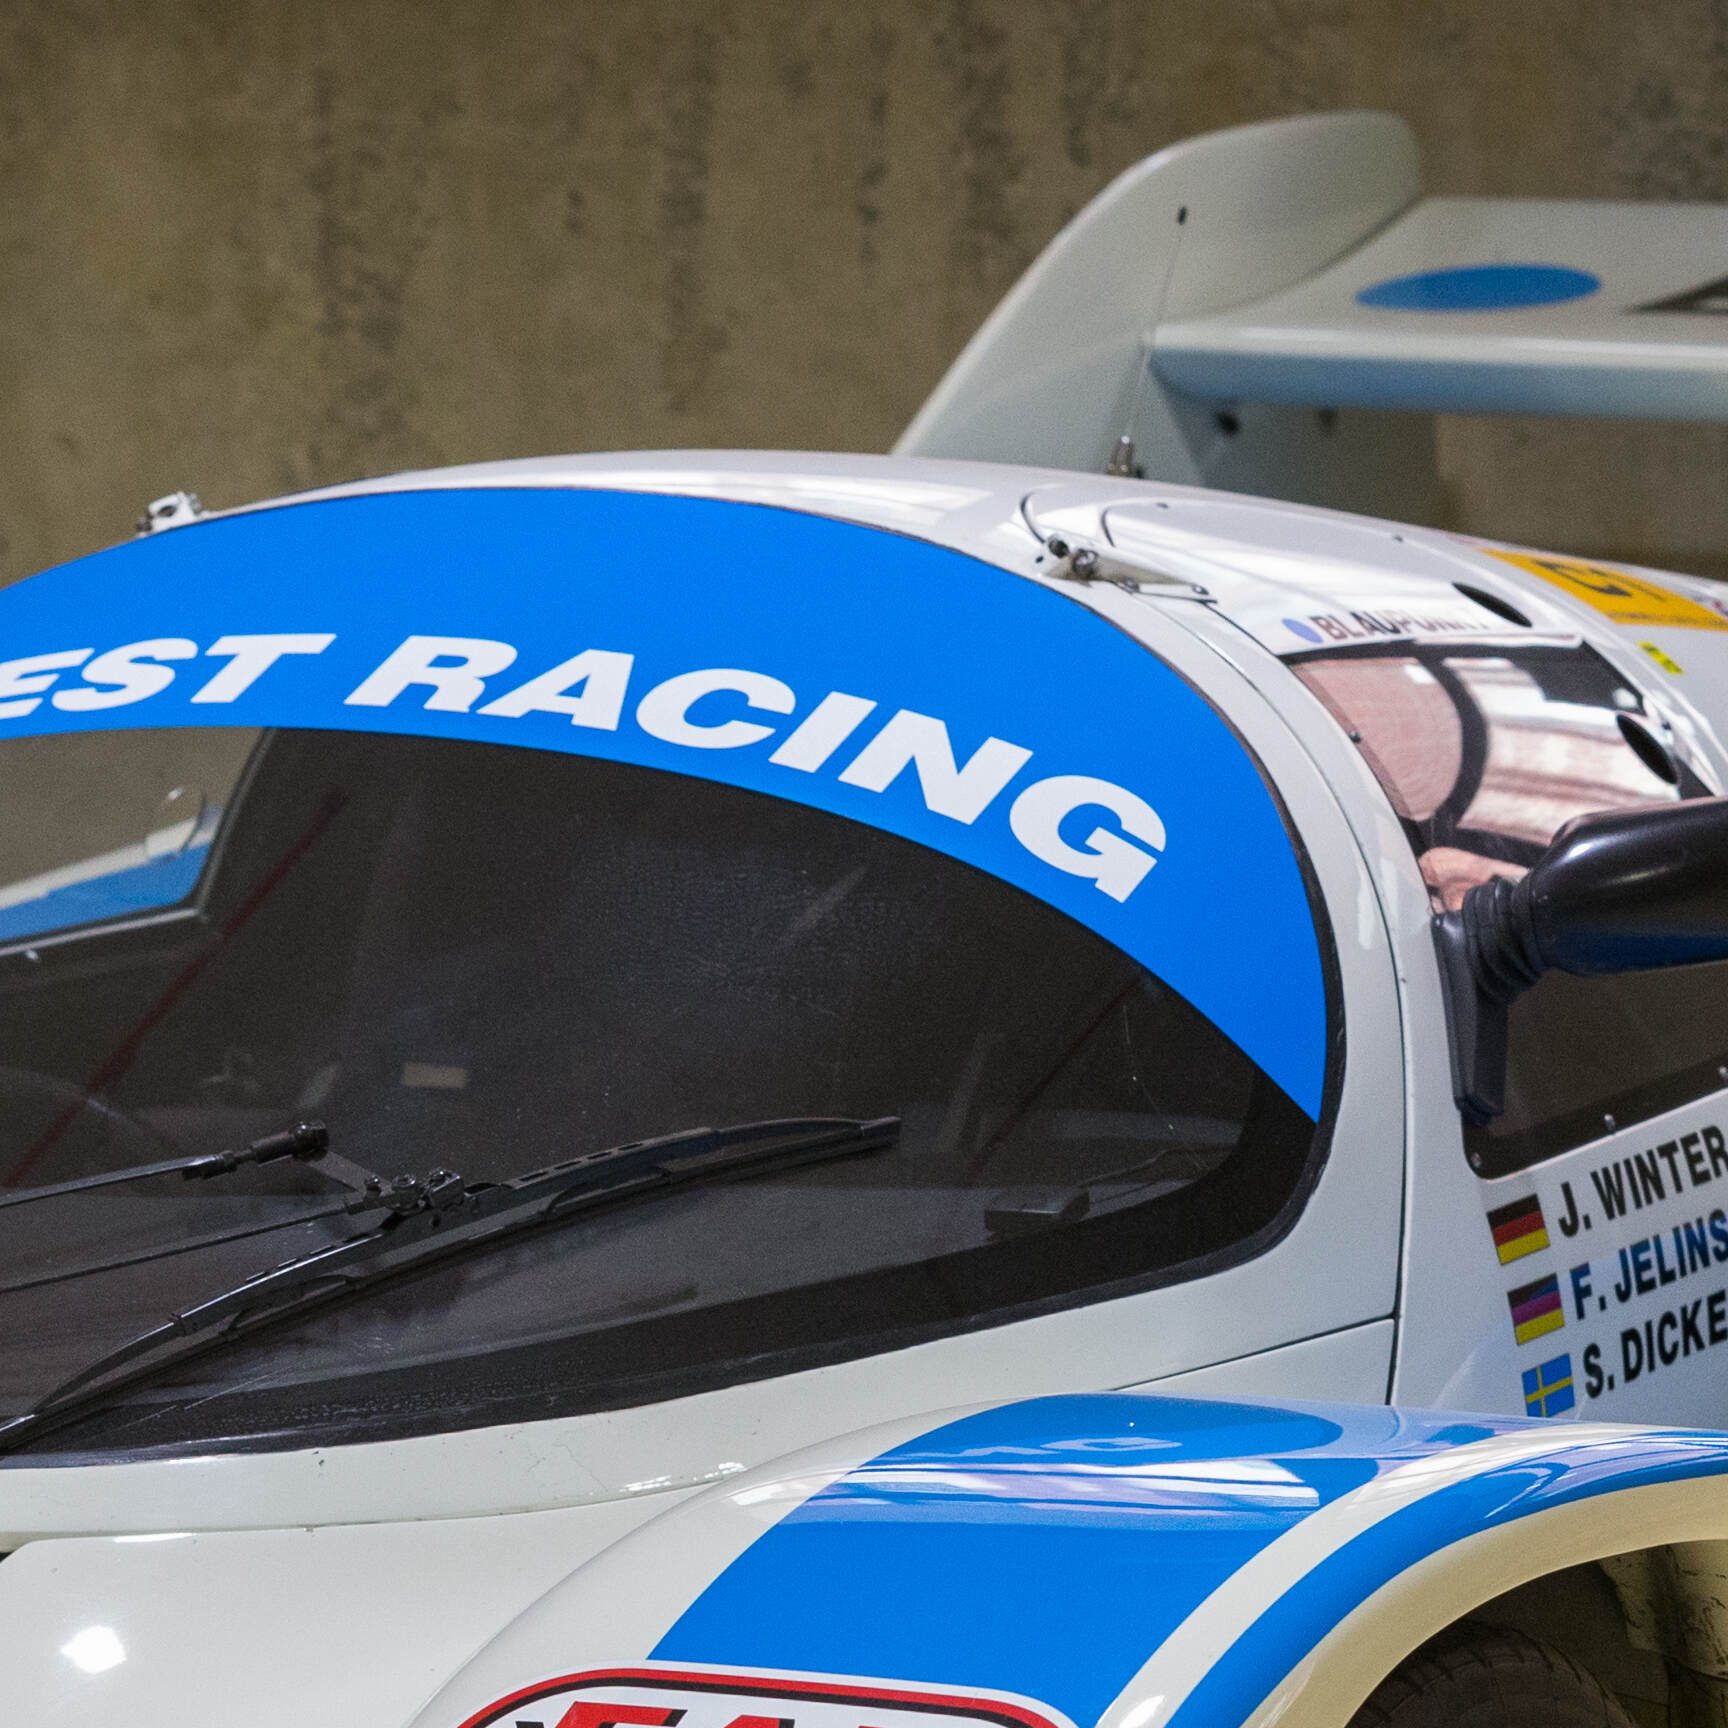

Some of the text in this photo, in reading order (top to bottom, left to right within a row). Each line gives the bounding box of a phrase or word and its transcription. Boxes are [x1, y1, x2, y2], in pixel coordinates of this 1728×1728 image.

[343, 634, 1168, 904] RACING
[1557, 1181, 1592, 1239] J.
[1569, 1261, 1607, 1321] F.
[1582, 1342, 1616, 1399] S.
